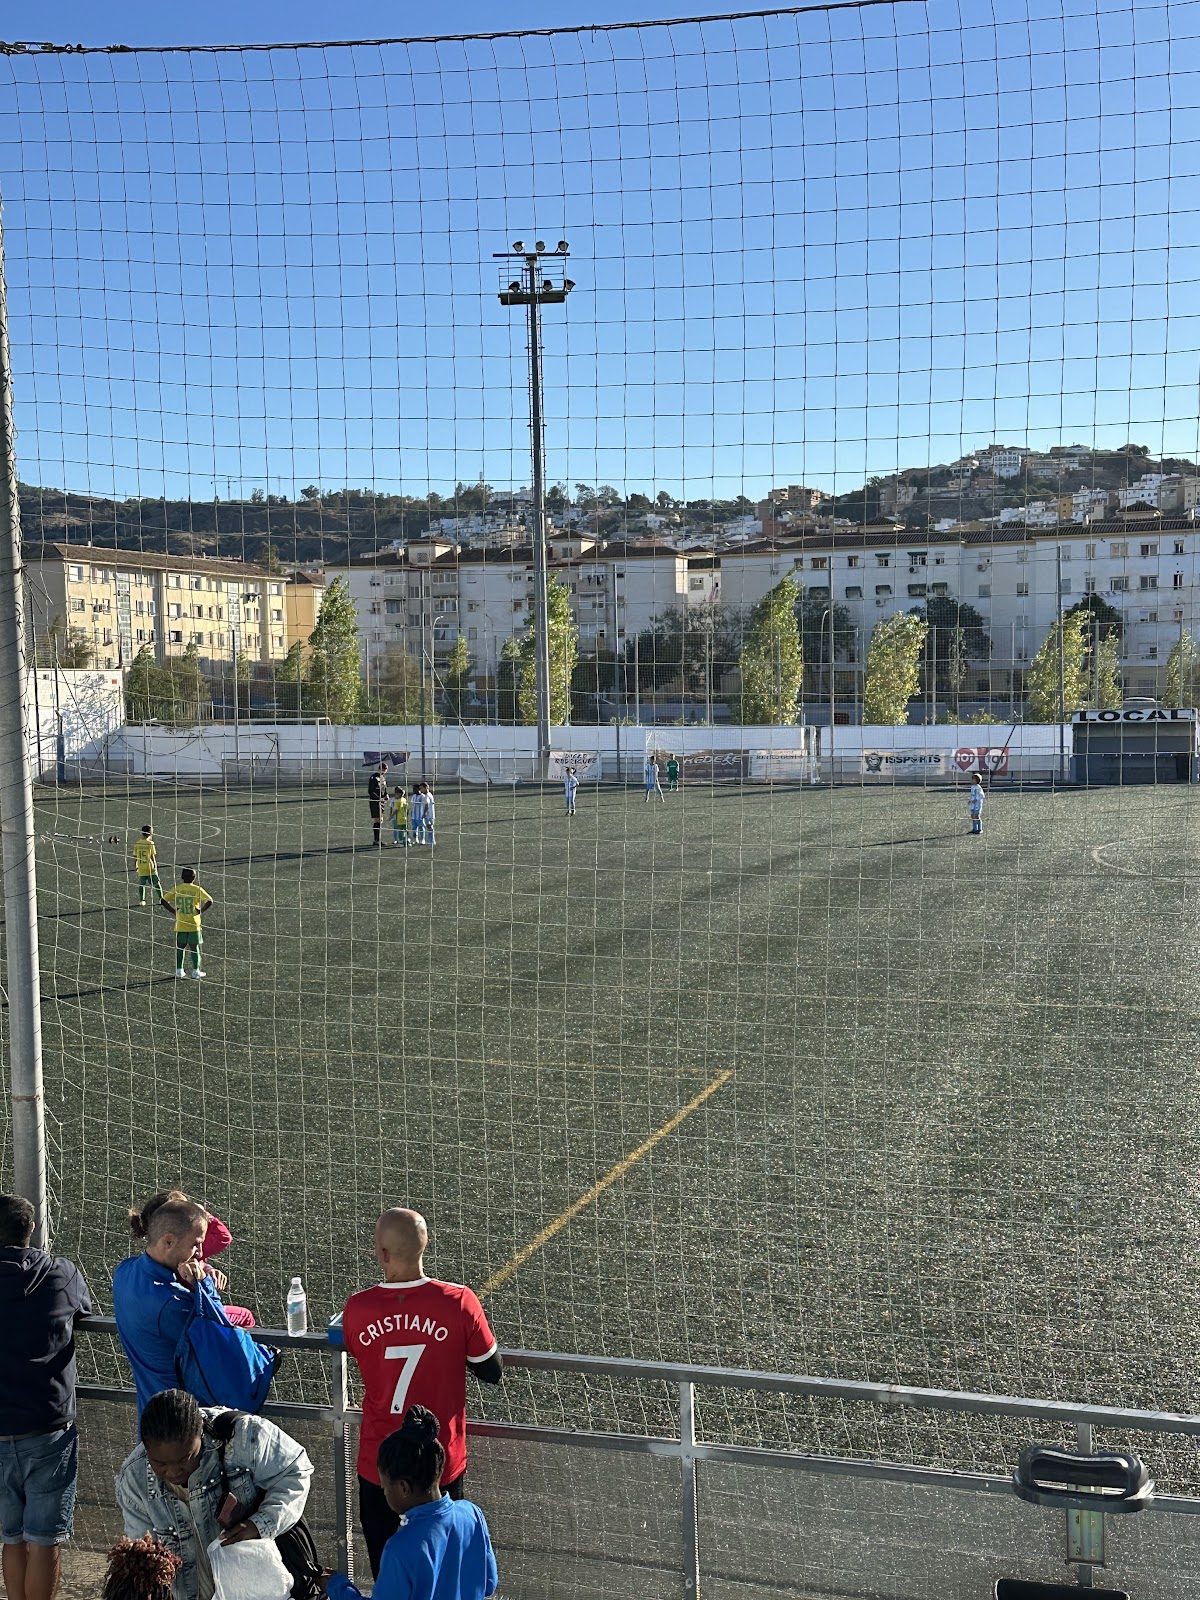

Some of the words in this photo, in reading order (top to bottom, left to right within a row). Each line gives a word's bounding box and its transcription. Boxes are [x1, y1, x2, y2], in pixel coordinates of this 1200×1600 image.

[1080, 710, 1189, 721] LOCAL
[359, 1314, 448, 1346] CRISTIANO
[384, 1344, 426, 1414] 7
